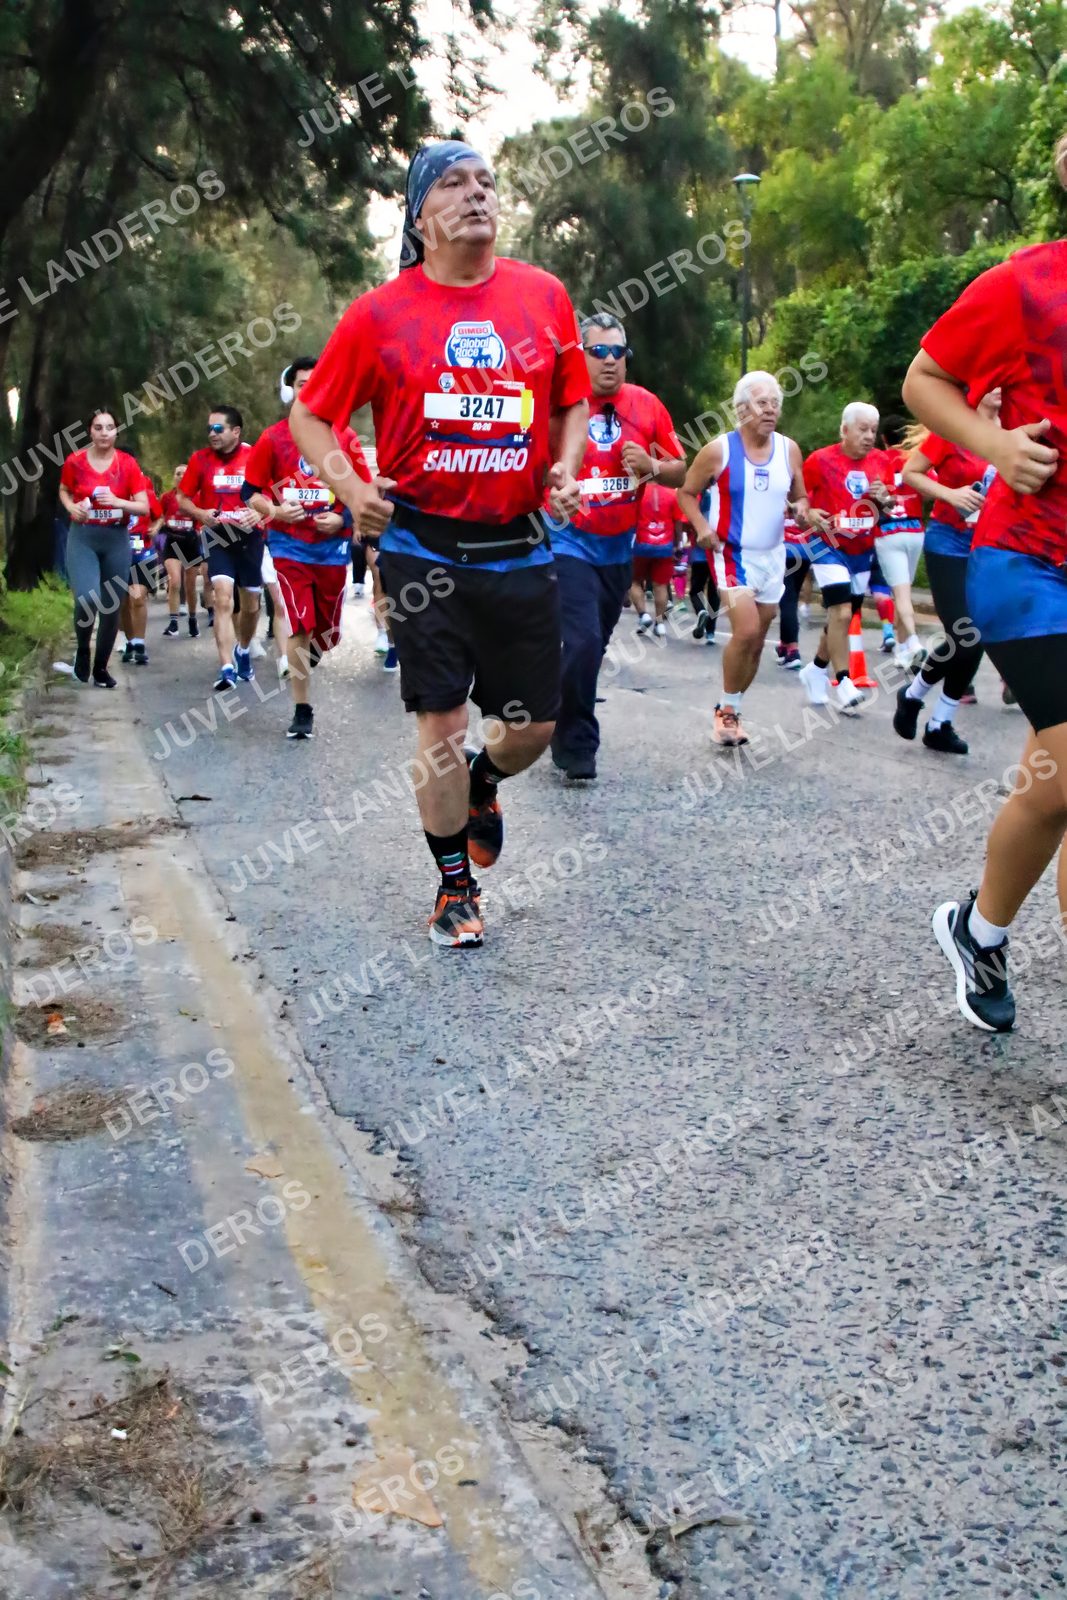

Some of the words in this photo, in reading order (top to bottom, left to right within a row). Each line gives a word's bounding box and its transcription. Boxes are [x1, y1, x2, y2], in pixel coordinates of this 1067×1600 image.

[457, 327, 489, 335] BIMBO
[460, 338, 489, 348] Global
[455, 348, 479, 358] Race
[459, 396, 505, 419] 3247
[423, 448, 528, 473] SANTIAGO
[603, 478, 629, 491] 3269
[298, 489, 320, 500] 3272
